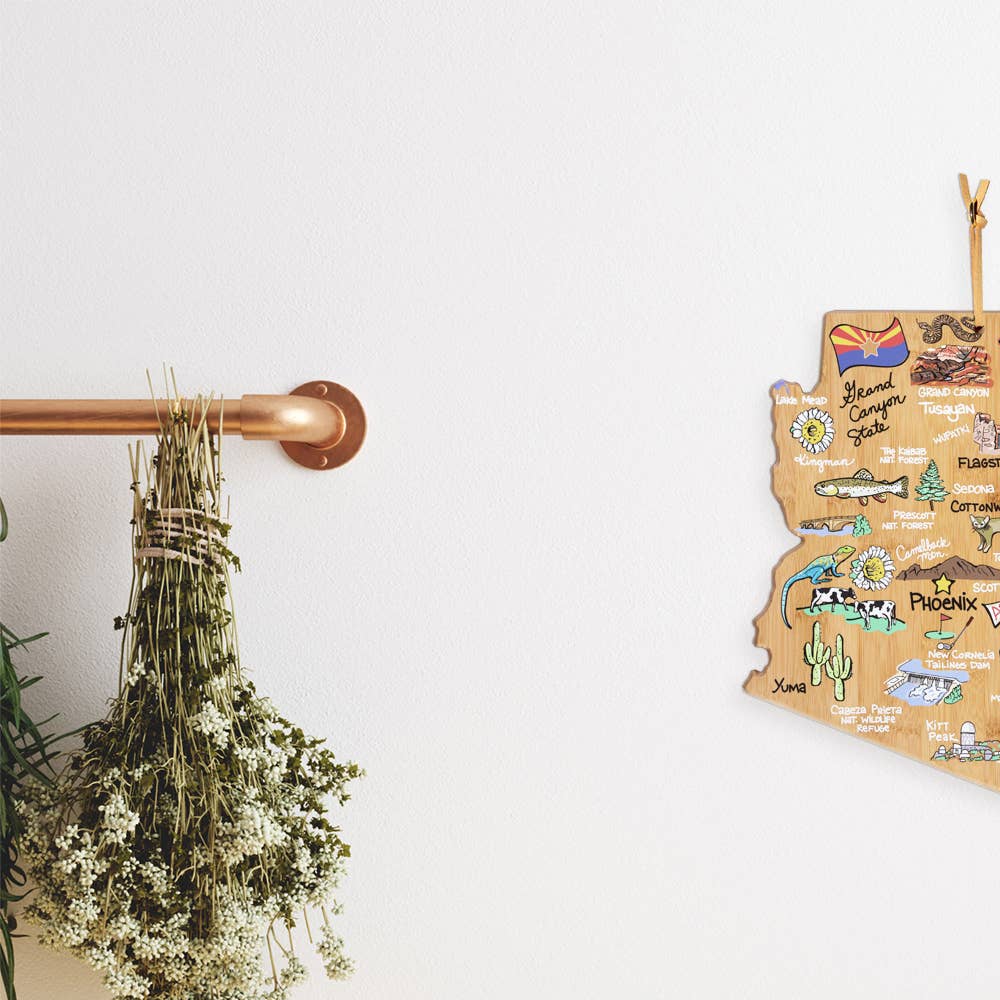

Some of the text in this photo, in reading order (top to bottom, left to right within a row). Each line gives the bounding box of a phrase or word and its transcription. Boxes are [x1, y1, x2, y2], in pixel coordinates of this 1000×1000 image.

[840, 372, 895, 408] Grand
[918, 387, 950, 397] GRAND
[850, 395, 906, 422] Canyon
[847, 419, 890, 446] State
[794, 453, 855, 473] Kingman
